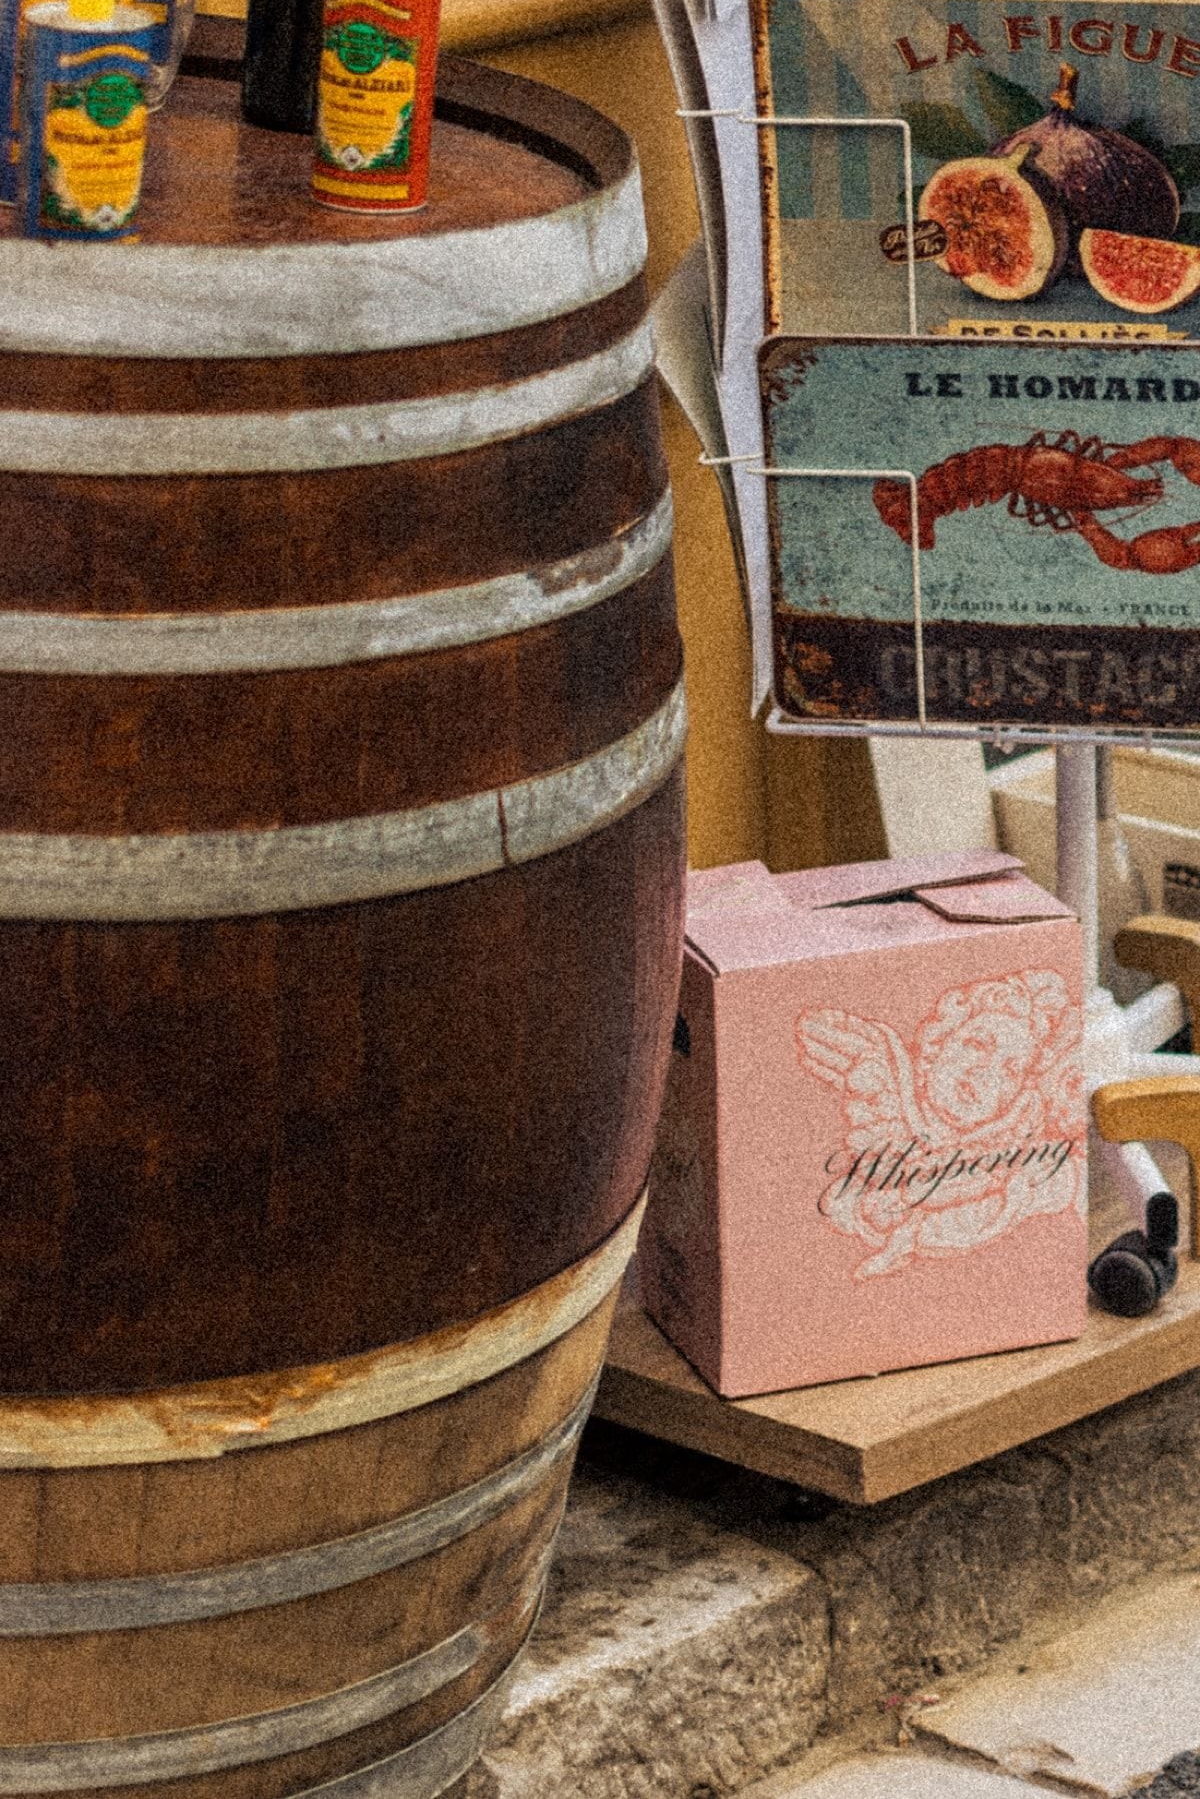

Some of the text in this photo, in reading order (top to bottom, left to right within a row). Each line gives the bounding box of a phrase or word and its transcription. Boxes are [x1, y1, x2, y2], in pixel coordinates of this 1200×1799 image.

[894, 21, 984, 75] LA
[905, 372, 963, 399] LE
[817, 1134, 1078, 1216] Whispering
